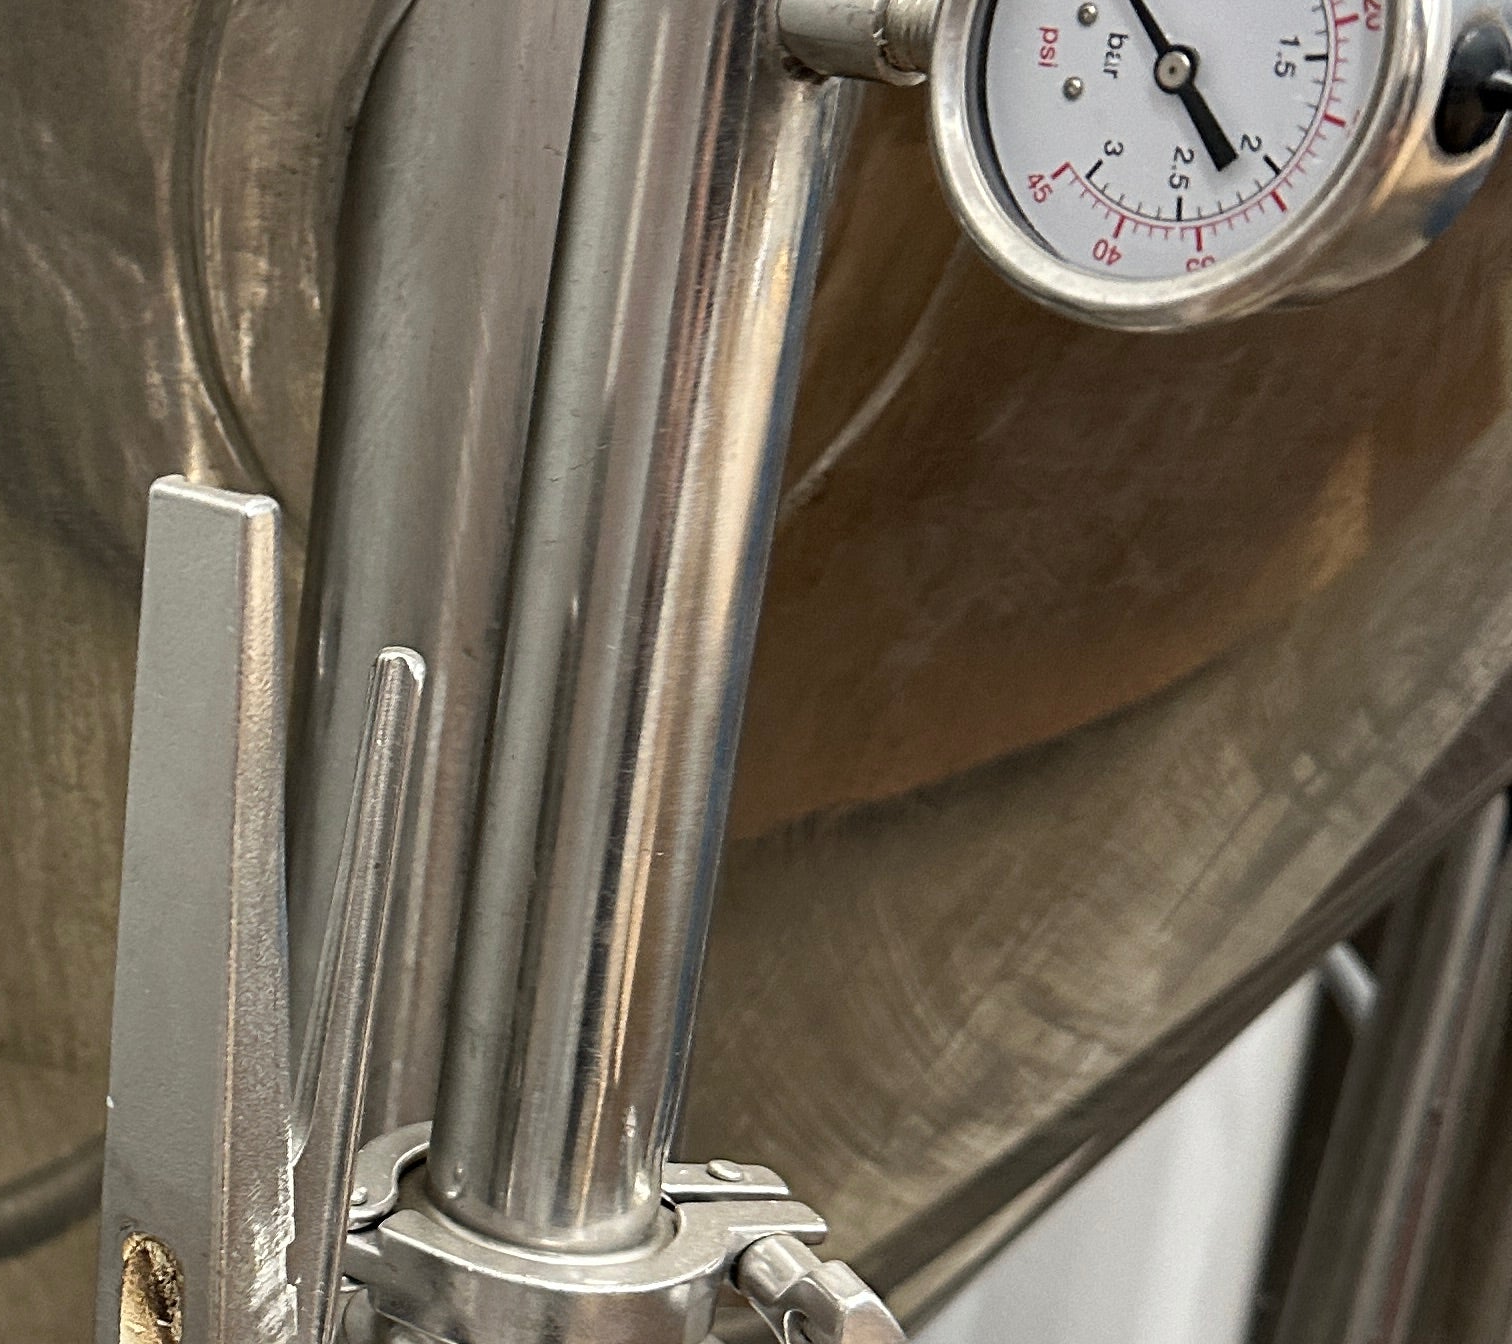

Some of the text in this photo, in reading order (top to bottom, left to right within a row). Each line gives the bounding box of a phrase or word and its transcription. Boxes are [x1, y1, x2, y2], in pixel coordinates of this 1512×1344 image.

[1038, 26, 1059, 69] psi
[1103, 33, 1129, 79] bar
[1274, 36, 1300, 78] 1.5
[1103, 140, 1124, 157] 3
[1241, 133, 1263, 153] 2
[1169, 146, 1195, 189] 2.5
[1027, 173, 1053, 204] 45
[1092, 239, 1122, 266] 40
